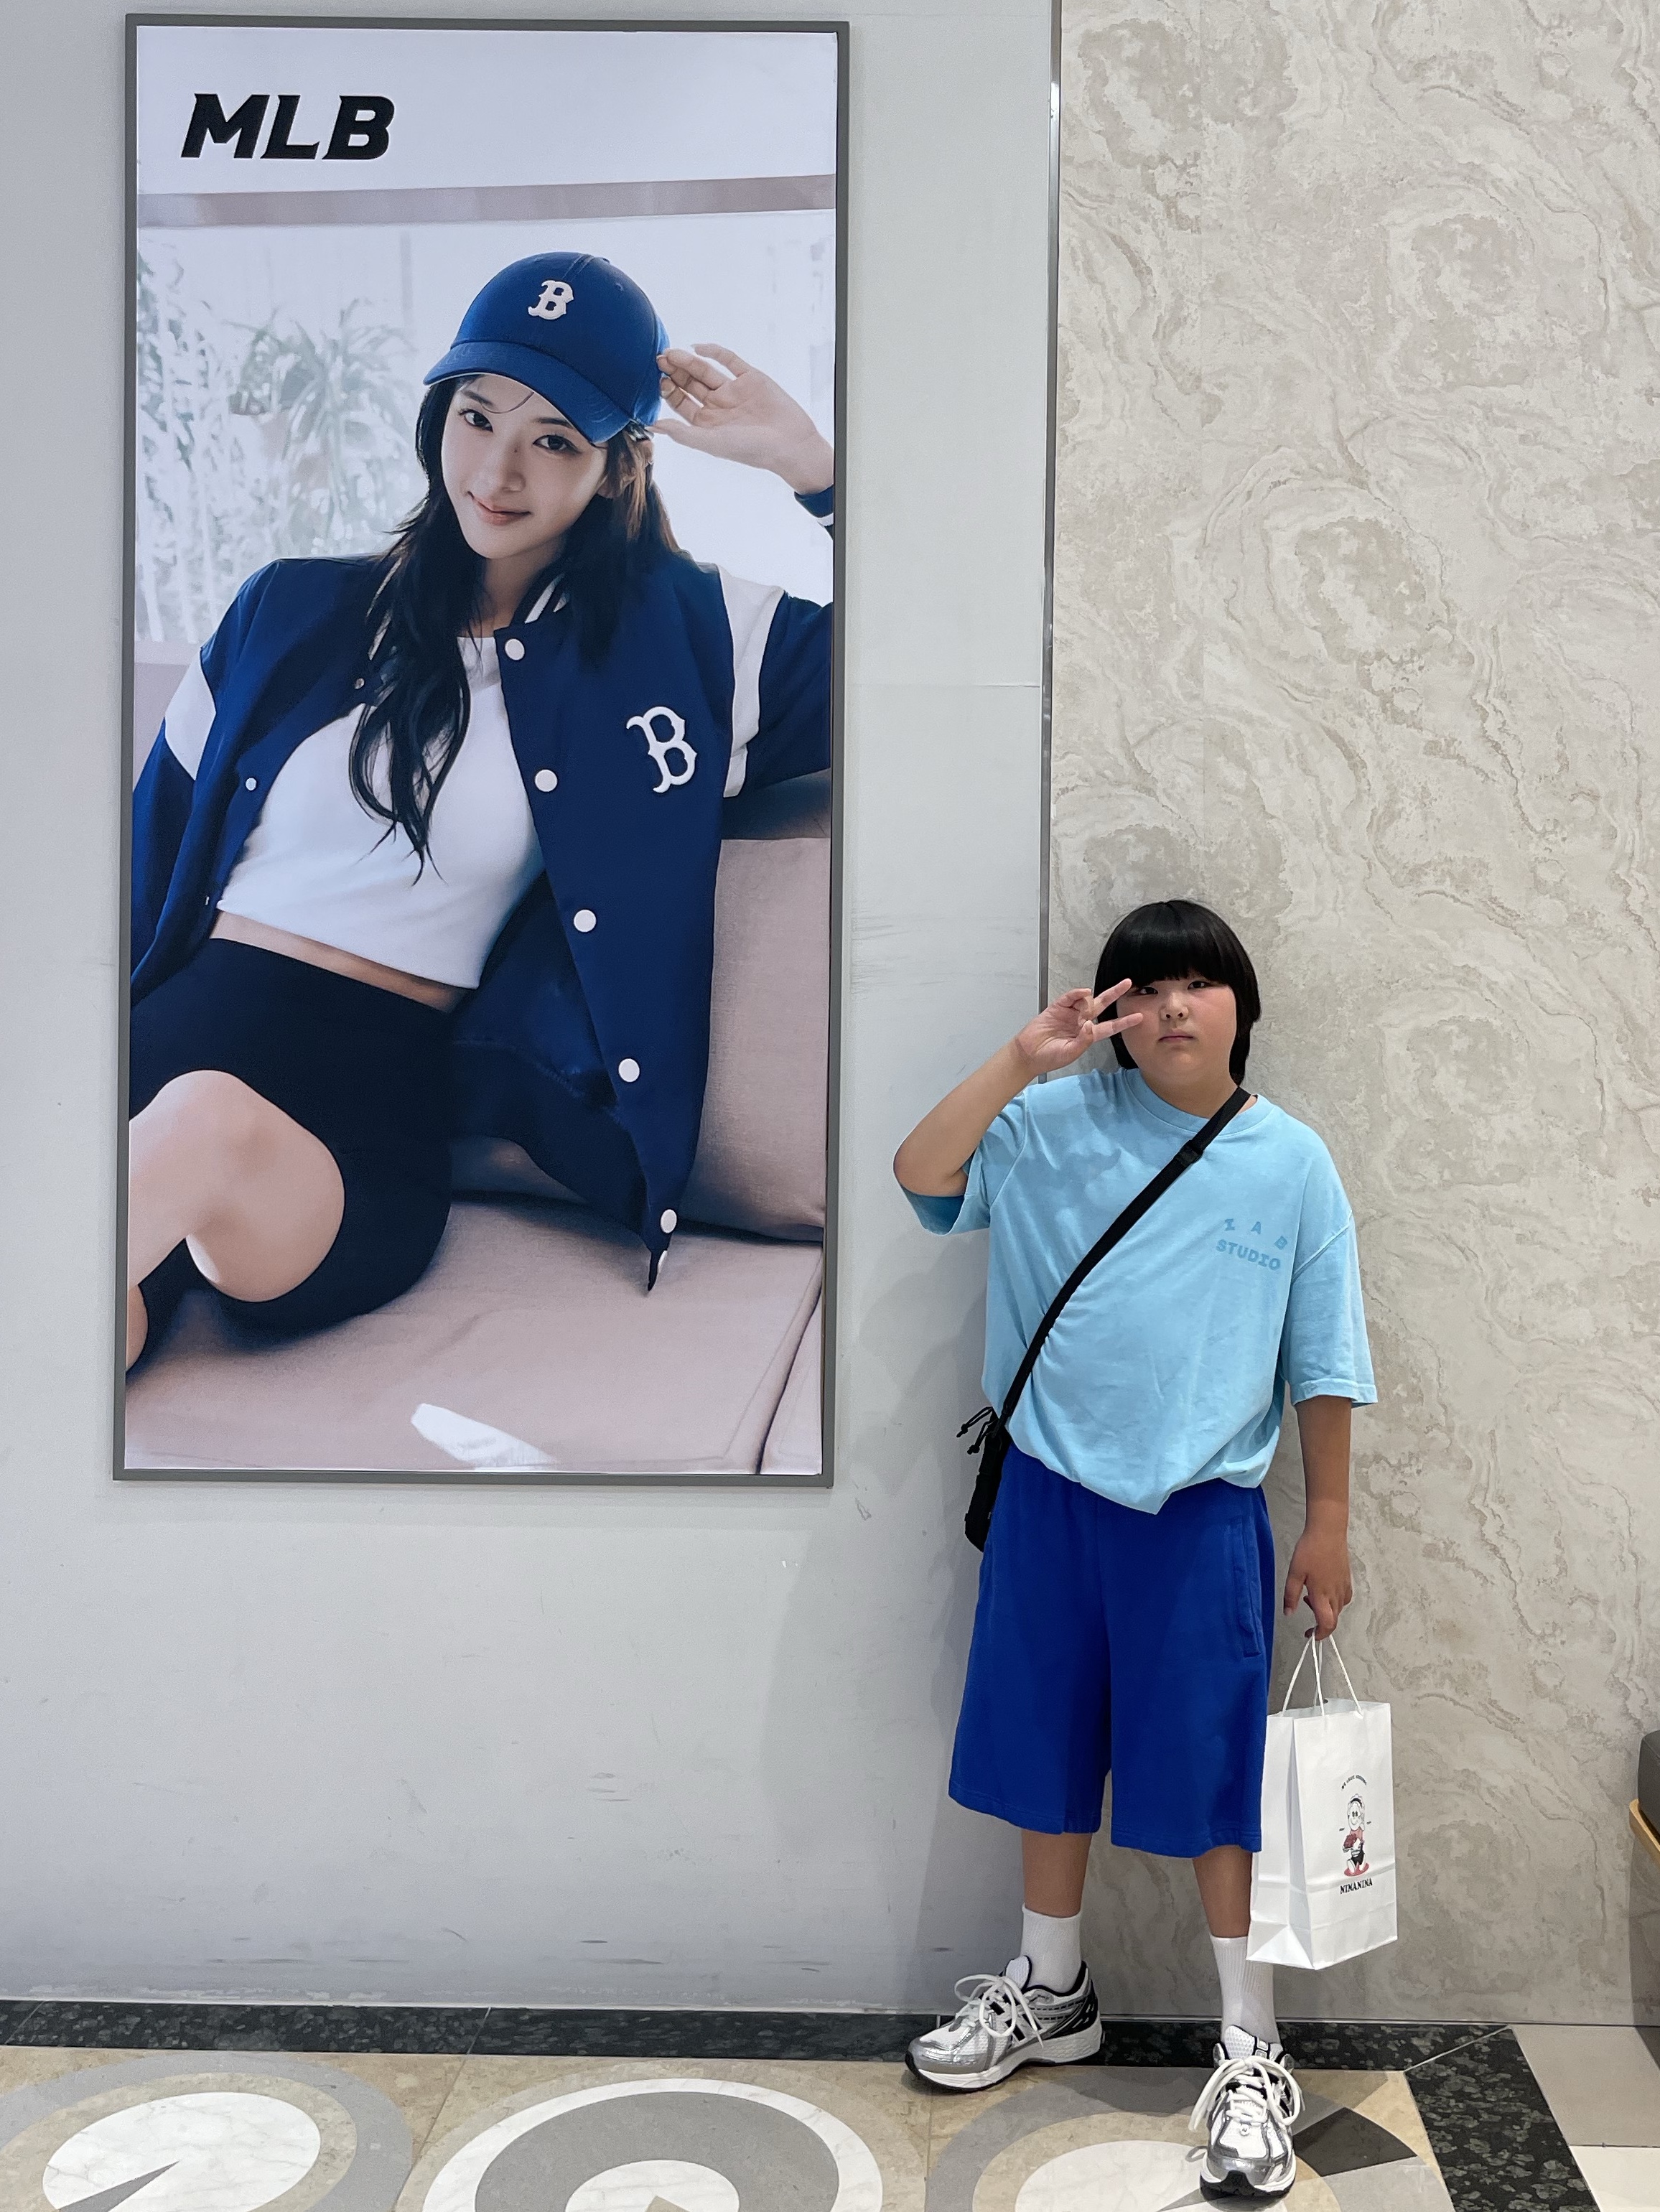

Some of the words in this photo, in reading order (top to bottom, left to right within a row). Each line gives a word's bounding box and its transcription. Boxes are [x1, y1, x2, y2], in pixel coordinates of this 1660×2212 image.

[180, 93, 395, 160] MLB
[528, 279, 574, 320] B
[626, 706, 698, 793] B
[1216, 1239, 1281, 1271] STUDIO
